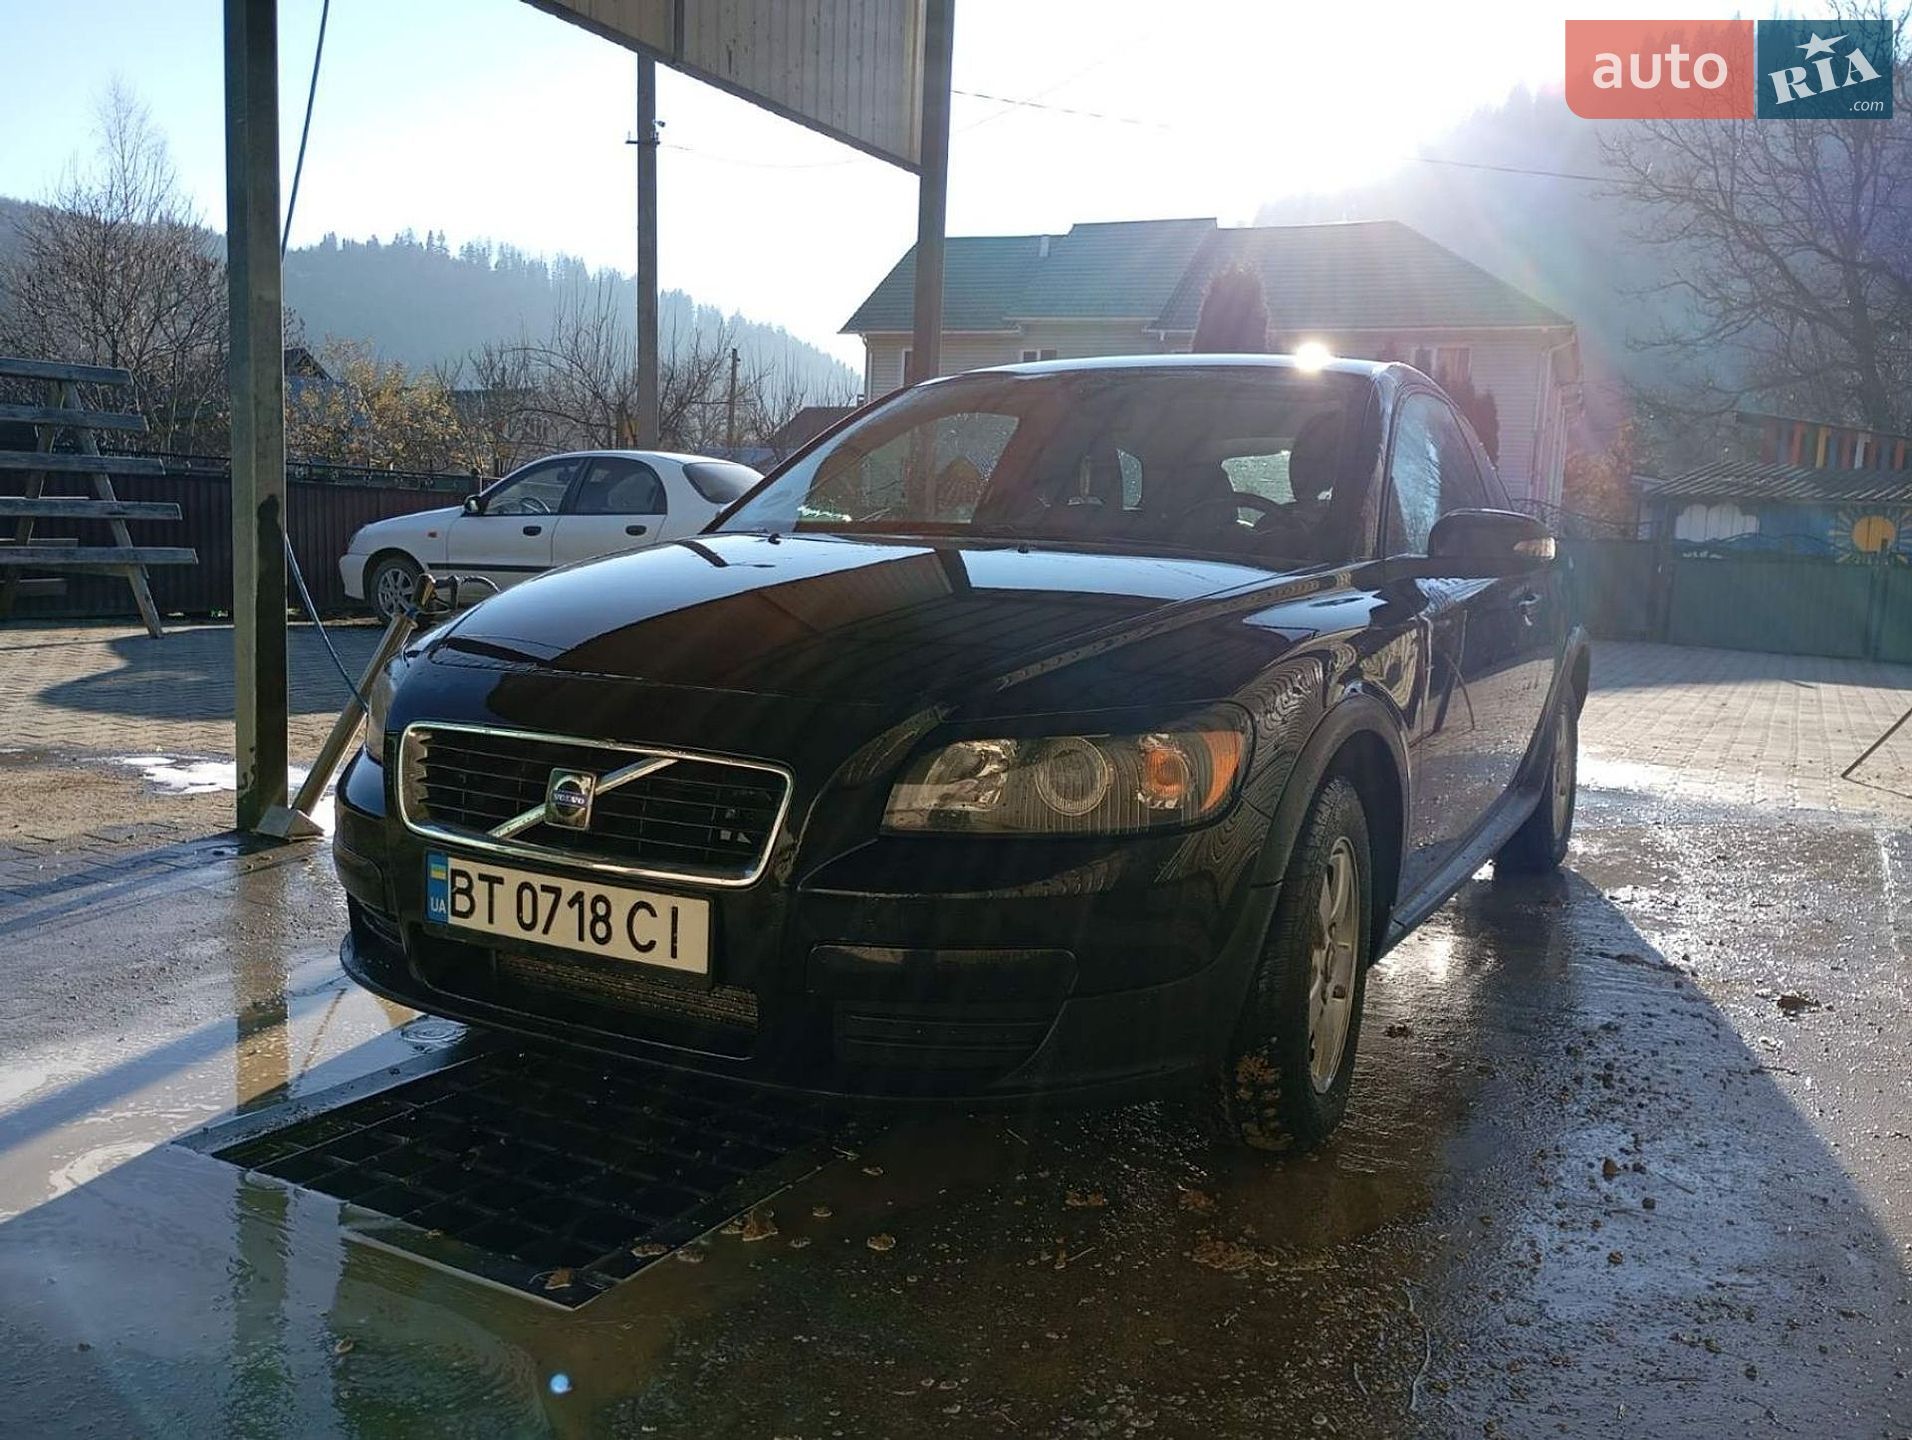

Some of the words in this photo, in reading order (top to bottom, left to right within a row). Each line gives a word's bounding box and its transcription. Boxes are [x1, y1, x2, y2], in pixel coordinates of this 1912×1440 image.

[553, 792, 585, 805] VOLVO
[430, 895, 447, 914] UA
[450, 868, 504, 925] BT
[516, 881, 613, 945] 0718
[626, 900, 679, 959] CI
